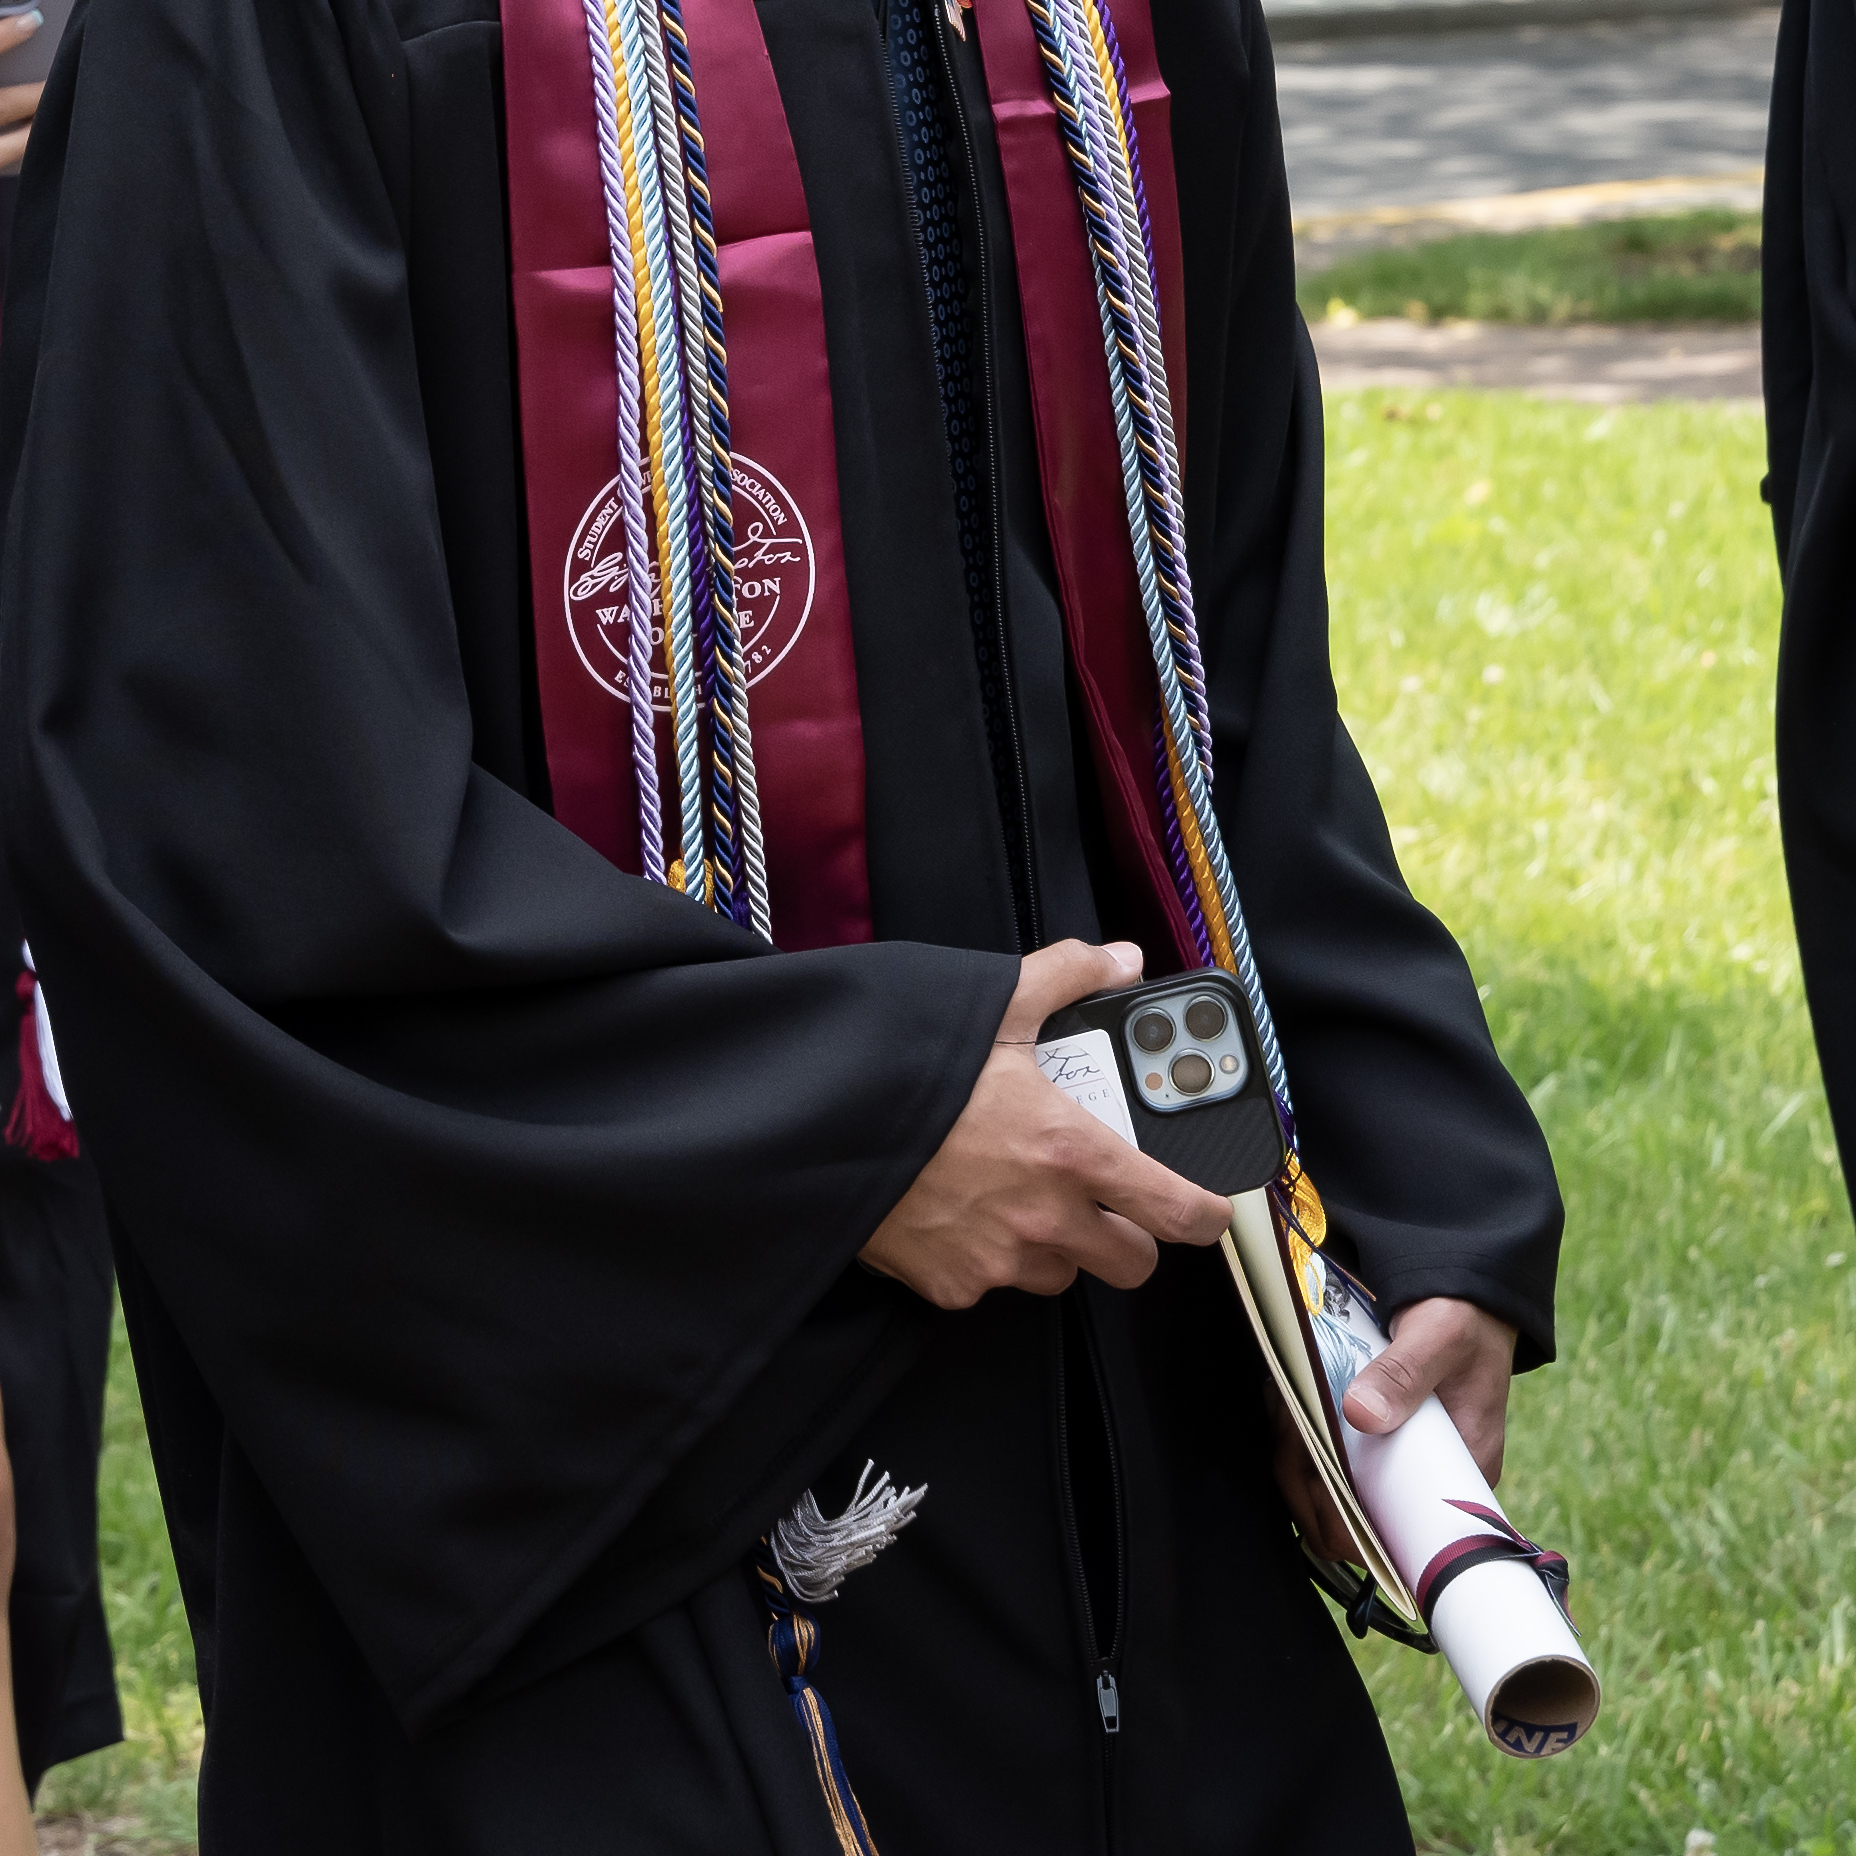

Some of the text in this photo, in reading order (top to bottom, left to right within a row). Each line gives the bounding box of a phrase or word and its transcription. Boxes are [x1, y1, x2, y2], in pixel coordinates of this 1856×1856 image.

[577, 468, 788, 561] STUDENT SOCIATION
[745, 645, 772, 674] 782
